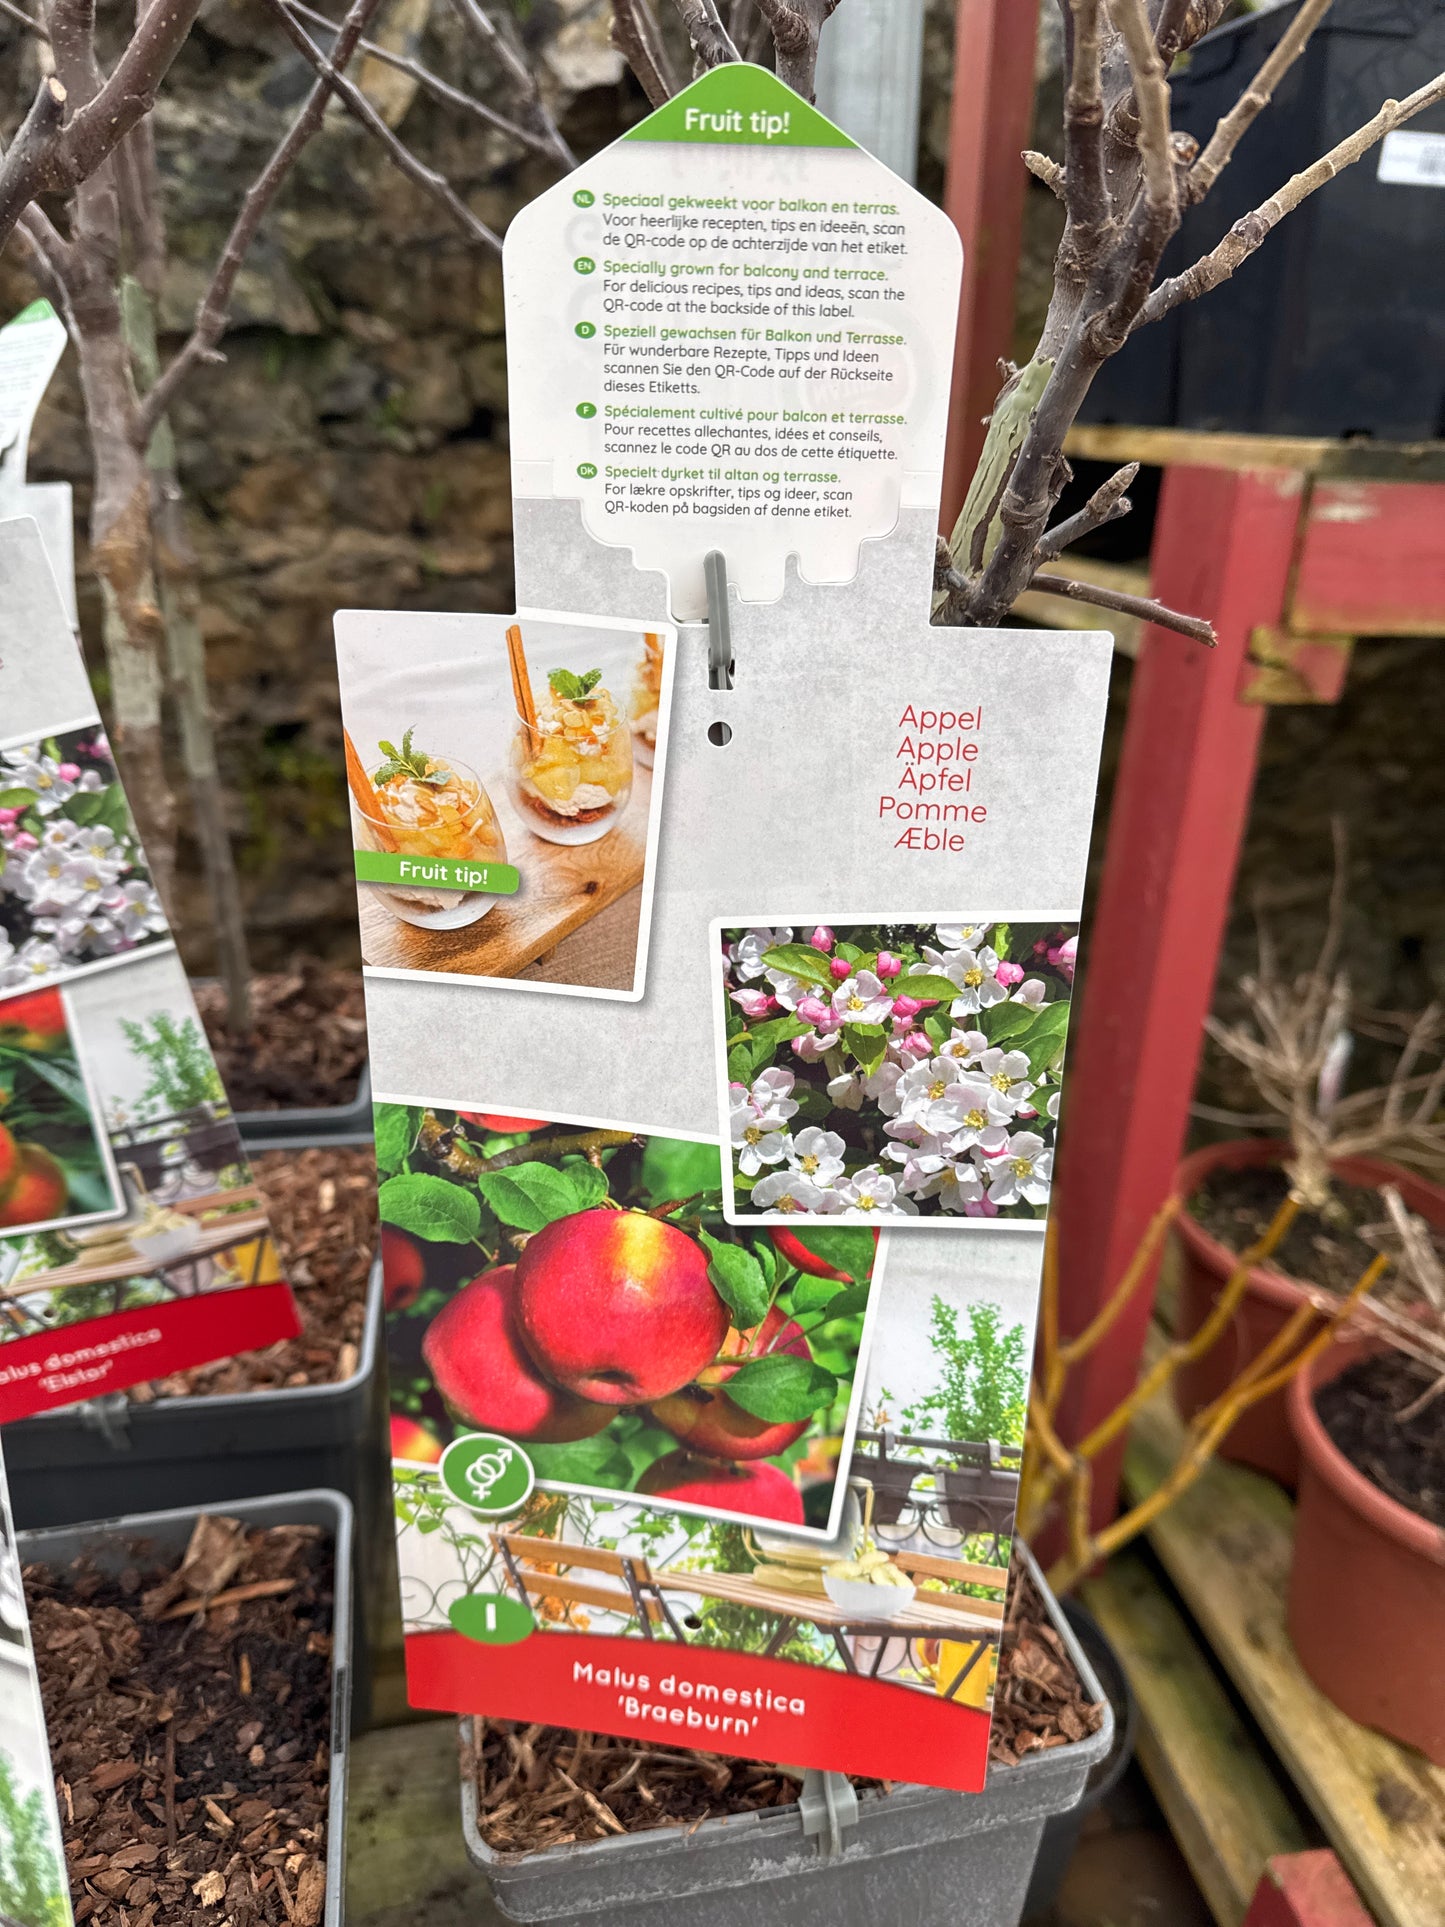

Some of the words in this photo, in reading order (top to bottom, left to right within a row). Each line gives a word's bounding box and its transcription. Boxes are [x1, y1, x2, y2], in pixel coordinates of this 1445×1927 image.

[685, 108, 743, 132] Fruit
[749, 109, 790, 139] tip!
[576, 194, 591, 204] NL
[603, 192, 664, 209] Speciaal
[668, 195, 738, 211] gekweekt
[741, 200, 776, 214] voor
[778, 198, 828, 212] balkon
[831, 202, 849, 213] en
[852, 202, 900, 215] terras.
[602, 213, 637, 227] Voor
[640, 213, 699, 231] heerlijke
[702, 218, 768, 233] recepten,
[770, 218, 796, 234] tips
[799, 222, 817, 232] en
[820, 219, 870, 236] ideeën,
[872, 224, 905, 235] scan
[602, 232, 621, 246] de
[624, 233, 686, 249] QR-code
[688, 238, 708, 251] op
[710, 235, 729, 249] de
[732, 236, 808, 254] achterzijde
[811, 242, 837, 252] van
[841, 239, 864, 253] het
[866, 241, 908, 255] etiket.
[577, 261, 592, 271] EN
[603, 259, 666, 277] Specially
[670, 264, 714, 278] grown
[718, 262, 740, 276] for
[743, 263, 799, 281] balcony
[802, 266, 830, 279] and
[833, 268, 888, 281] terrace.
[603, 279, 627, 292] For
[629, 279, 689, 294] delicious
[692, 282, 744, 298] recipes,
[747, 284, 772, 299] tips
[775, 284, 802, 298] and
[805, 285, 845, 300] ideas,
[847, 289, 880, 300] scan
[883, 287, 905, 301] the
[603, 298, 663, 314] QR-code
[666, 301, 681, 313] at
[684, 300, 707, 313] the
[710, 300, 770, 315] backside
[773, 302, 789, 316] of
[791, 303, 816, 317] this
[819, 304, 855, 318] label.
[604, 324, 656, 340] Speziell
[660, 327, 737, 341] gewachsen
[740, 328, 762, 341] für
[765, 328, 812, 342] Balkon
[816, 330, 842, 343] und
[846, 331, 907, 345] Terrasse.
[604, 343, 626, 356] Für
[628, 344, 710, 358] wunderbare
[713, 346, 771, 362] Rezepte,
[774, 347, 810, 363] Tipps
[814, 349, 839, 362] und
[842, 349, 879, 363] Ideen
[604, 364, 659, 375] scannen
[662, 363, 683, 376] Sie
[685, 363, 711, 376] den
[714, 364, 775, 379] QR-Code
[778, 366, 802, 379] auf
[804, 366, 827, 379] der
[830, 367, 894, 382] Rückseite
[603, 379, 645, 393] dieses
[649, 380, 700, 394] Etiketts.
[604, 404, 696, 420] Spécialement
[699, 407, 744, 421] cultivé
[747, 411, 779, 423] pour
[782, 409, 827, 423] balcon
[831, 412, 845, 423] et
[849, 412, 907, 425] terrasse.
[604, 423, 635, 436] Pour
[638, 425, 691, 437] recettes
[694, 425, 771, 441] allechantes,
[775, 427, 809, 440] idées
[812, 429, 826, 441] et
[828, 429, 883, 444] conseils,
[604, 443, 657, 454] scannez
[661, 441, 672, 454] le
[675, 442, 708, 455] code
[711, 443, 731, 458] QR
[734, 446, 751, 456] au
[754, 444, 778, 457] dos
[781, 444, 798, 458] de
[801, 447, 834, 458] cette
[837, 446, 898, 462] étiquette.
[580, 467, 594, 475] DK
[605, 465, 657, 480] Specielt
[661, 466, 704, 482] dyrket
[708, 468, 721, 480] til
[724, 468, 759, 481] altan
[762, 471, 780, 484] og
[783, 471, 841, 483] terrasse.
[605, 483, 627, 495] For
[630, 483, 666, 496] lækre
[669, 484, 734, 500] opskrifter,
[737, 486, 761, 501] tips
[764, 489, 781, 502] og
[784, 487, 820, 502] ideer,
[822, 491, 853, 501] scan
[604, 500, 669, 515] QR-koden
[672, 501, 689, 516] på
[692, 502, 751, 517] bagsiden
[754, 503, 768, 516] af
[771, 504, 811, 517] denne
[814, 505, 852, 518] etiket.
[899, 704, 982, 735] Appel
[896, 736, 979, 766] Apple
[898, 762, 971, 796] Äpfel
[879, 796, 987, 823] Pomme
[894, 827, 965, 851] Æble
[400, 861, 448, 881] Fruit
[455, 867, 488, 887] tip!
[0, 1362, 42, 1385] alus
[44, 1328, 162, 1371] domestica
[573, 1660, 650, 1691] Malus
[659, 1674, 805, 1716] domestica
[618, 1695, 758, 1736] 'Braeburn'
